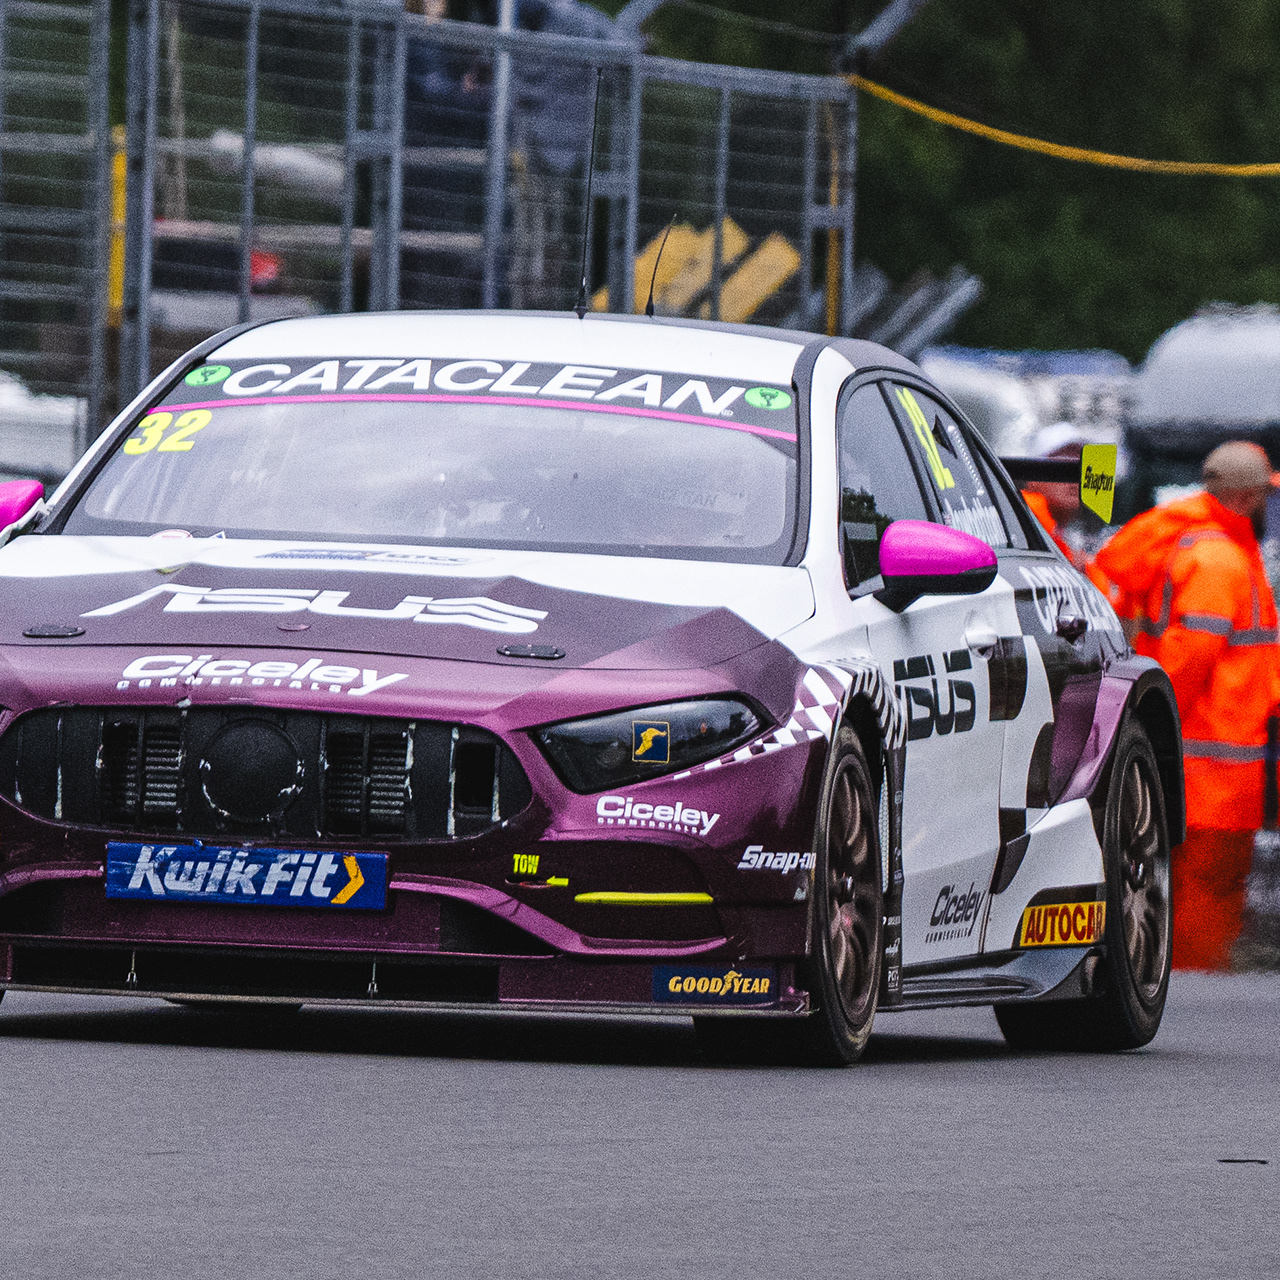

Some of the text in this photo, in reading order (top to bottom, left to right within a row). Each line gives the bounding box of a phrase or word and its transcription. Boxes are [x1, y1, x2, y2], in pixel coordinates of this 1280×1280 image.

[222, 359, 746, 416] CATACLEAN
[123, 409, 213, 455] 32
[78, 583, 550, 633] ASUS
[116, 676, 342, 694] COMMERCIALS
[122, 654, 410, 696] Ciceley
[596, 795, 720, 836] Ciceley
[513, 853, 541, 876] TOW
[929, 881, 988, 938] Ciceley
[1024, 903, 1104, 944] AUTOCAR
[668, 969, 770, 997] GOODYEAR
